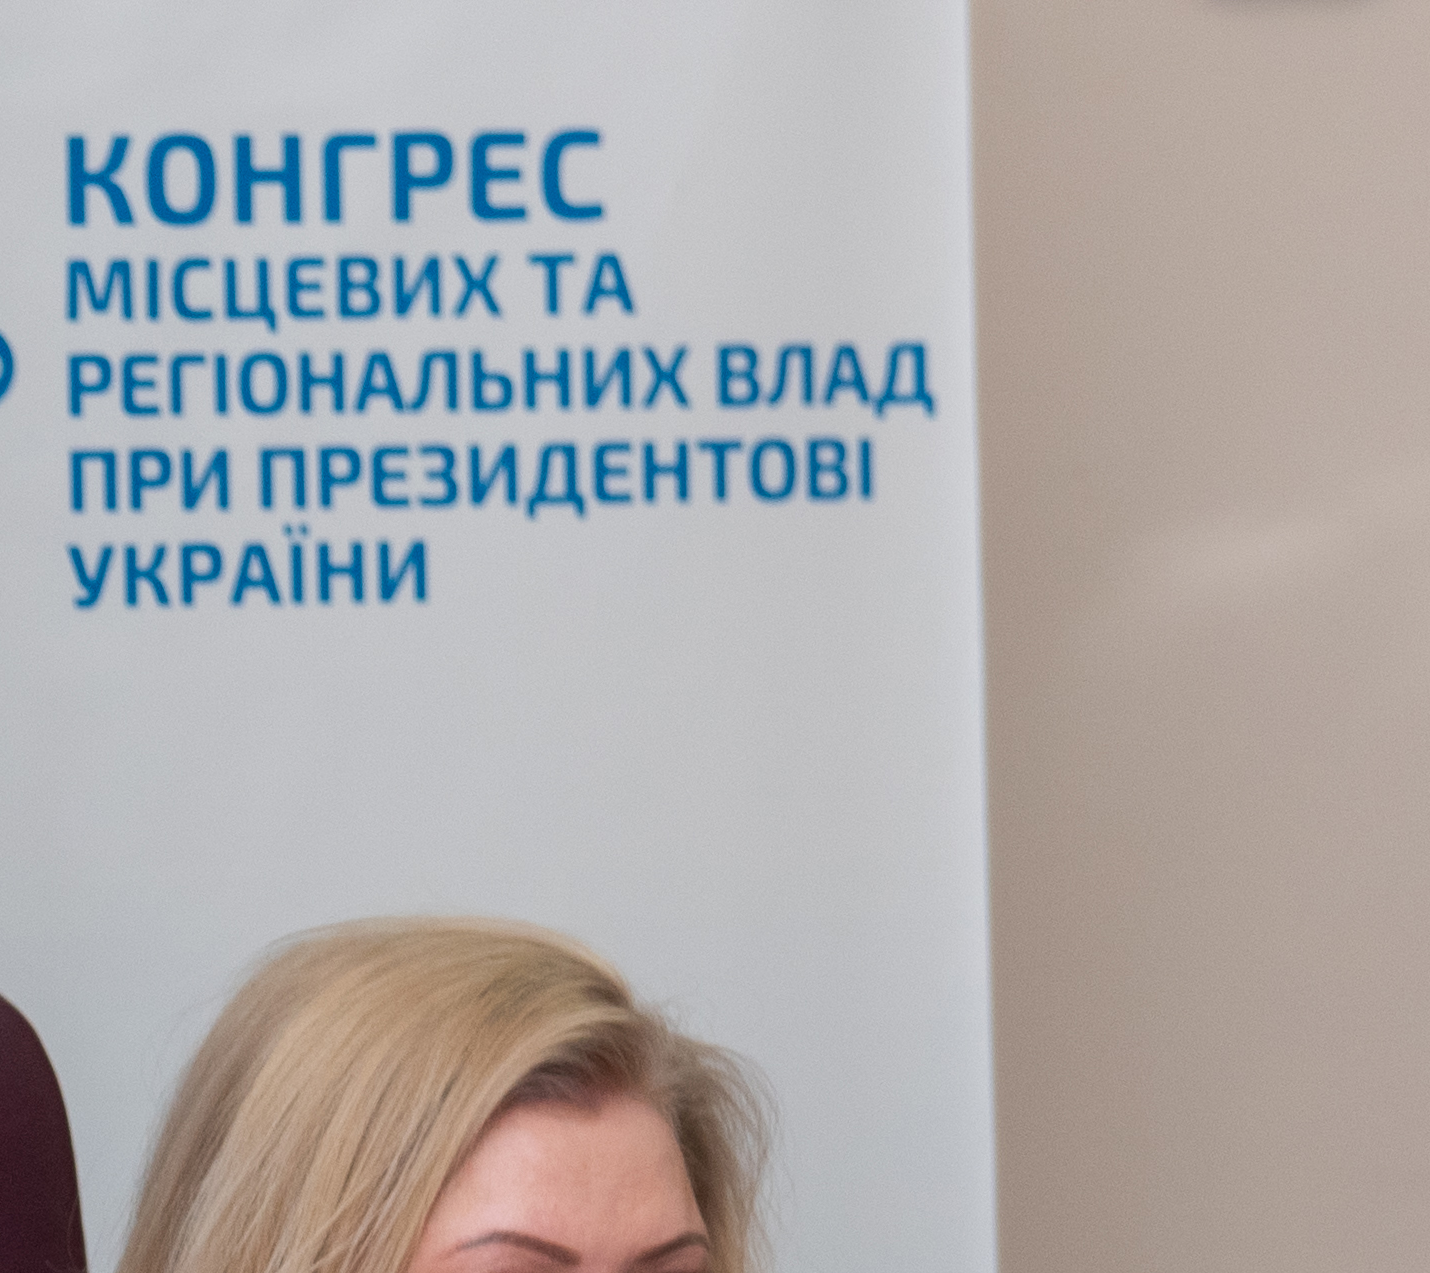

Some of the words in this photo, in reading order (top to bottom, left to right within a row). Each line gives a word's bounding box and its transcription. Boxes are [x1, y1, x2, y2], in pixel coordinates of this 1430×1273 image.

[66, 128, 604, 227] КОНГРЕС
[66, 254, 503, 331] МІСЦЕВИХ
[529, 253, 636, 315] ТА
[67, 345, 690, 417] РЕГІОНАЛЬНИХ
[715, 341, 937, 418] ВЛАД
[70, 447, 230, 512] ПРИ
[258, 437, 875, 519] ПРЕЗИДЕНТОВІ
[67, 524, 430, 607] УКРАЇНИ
